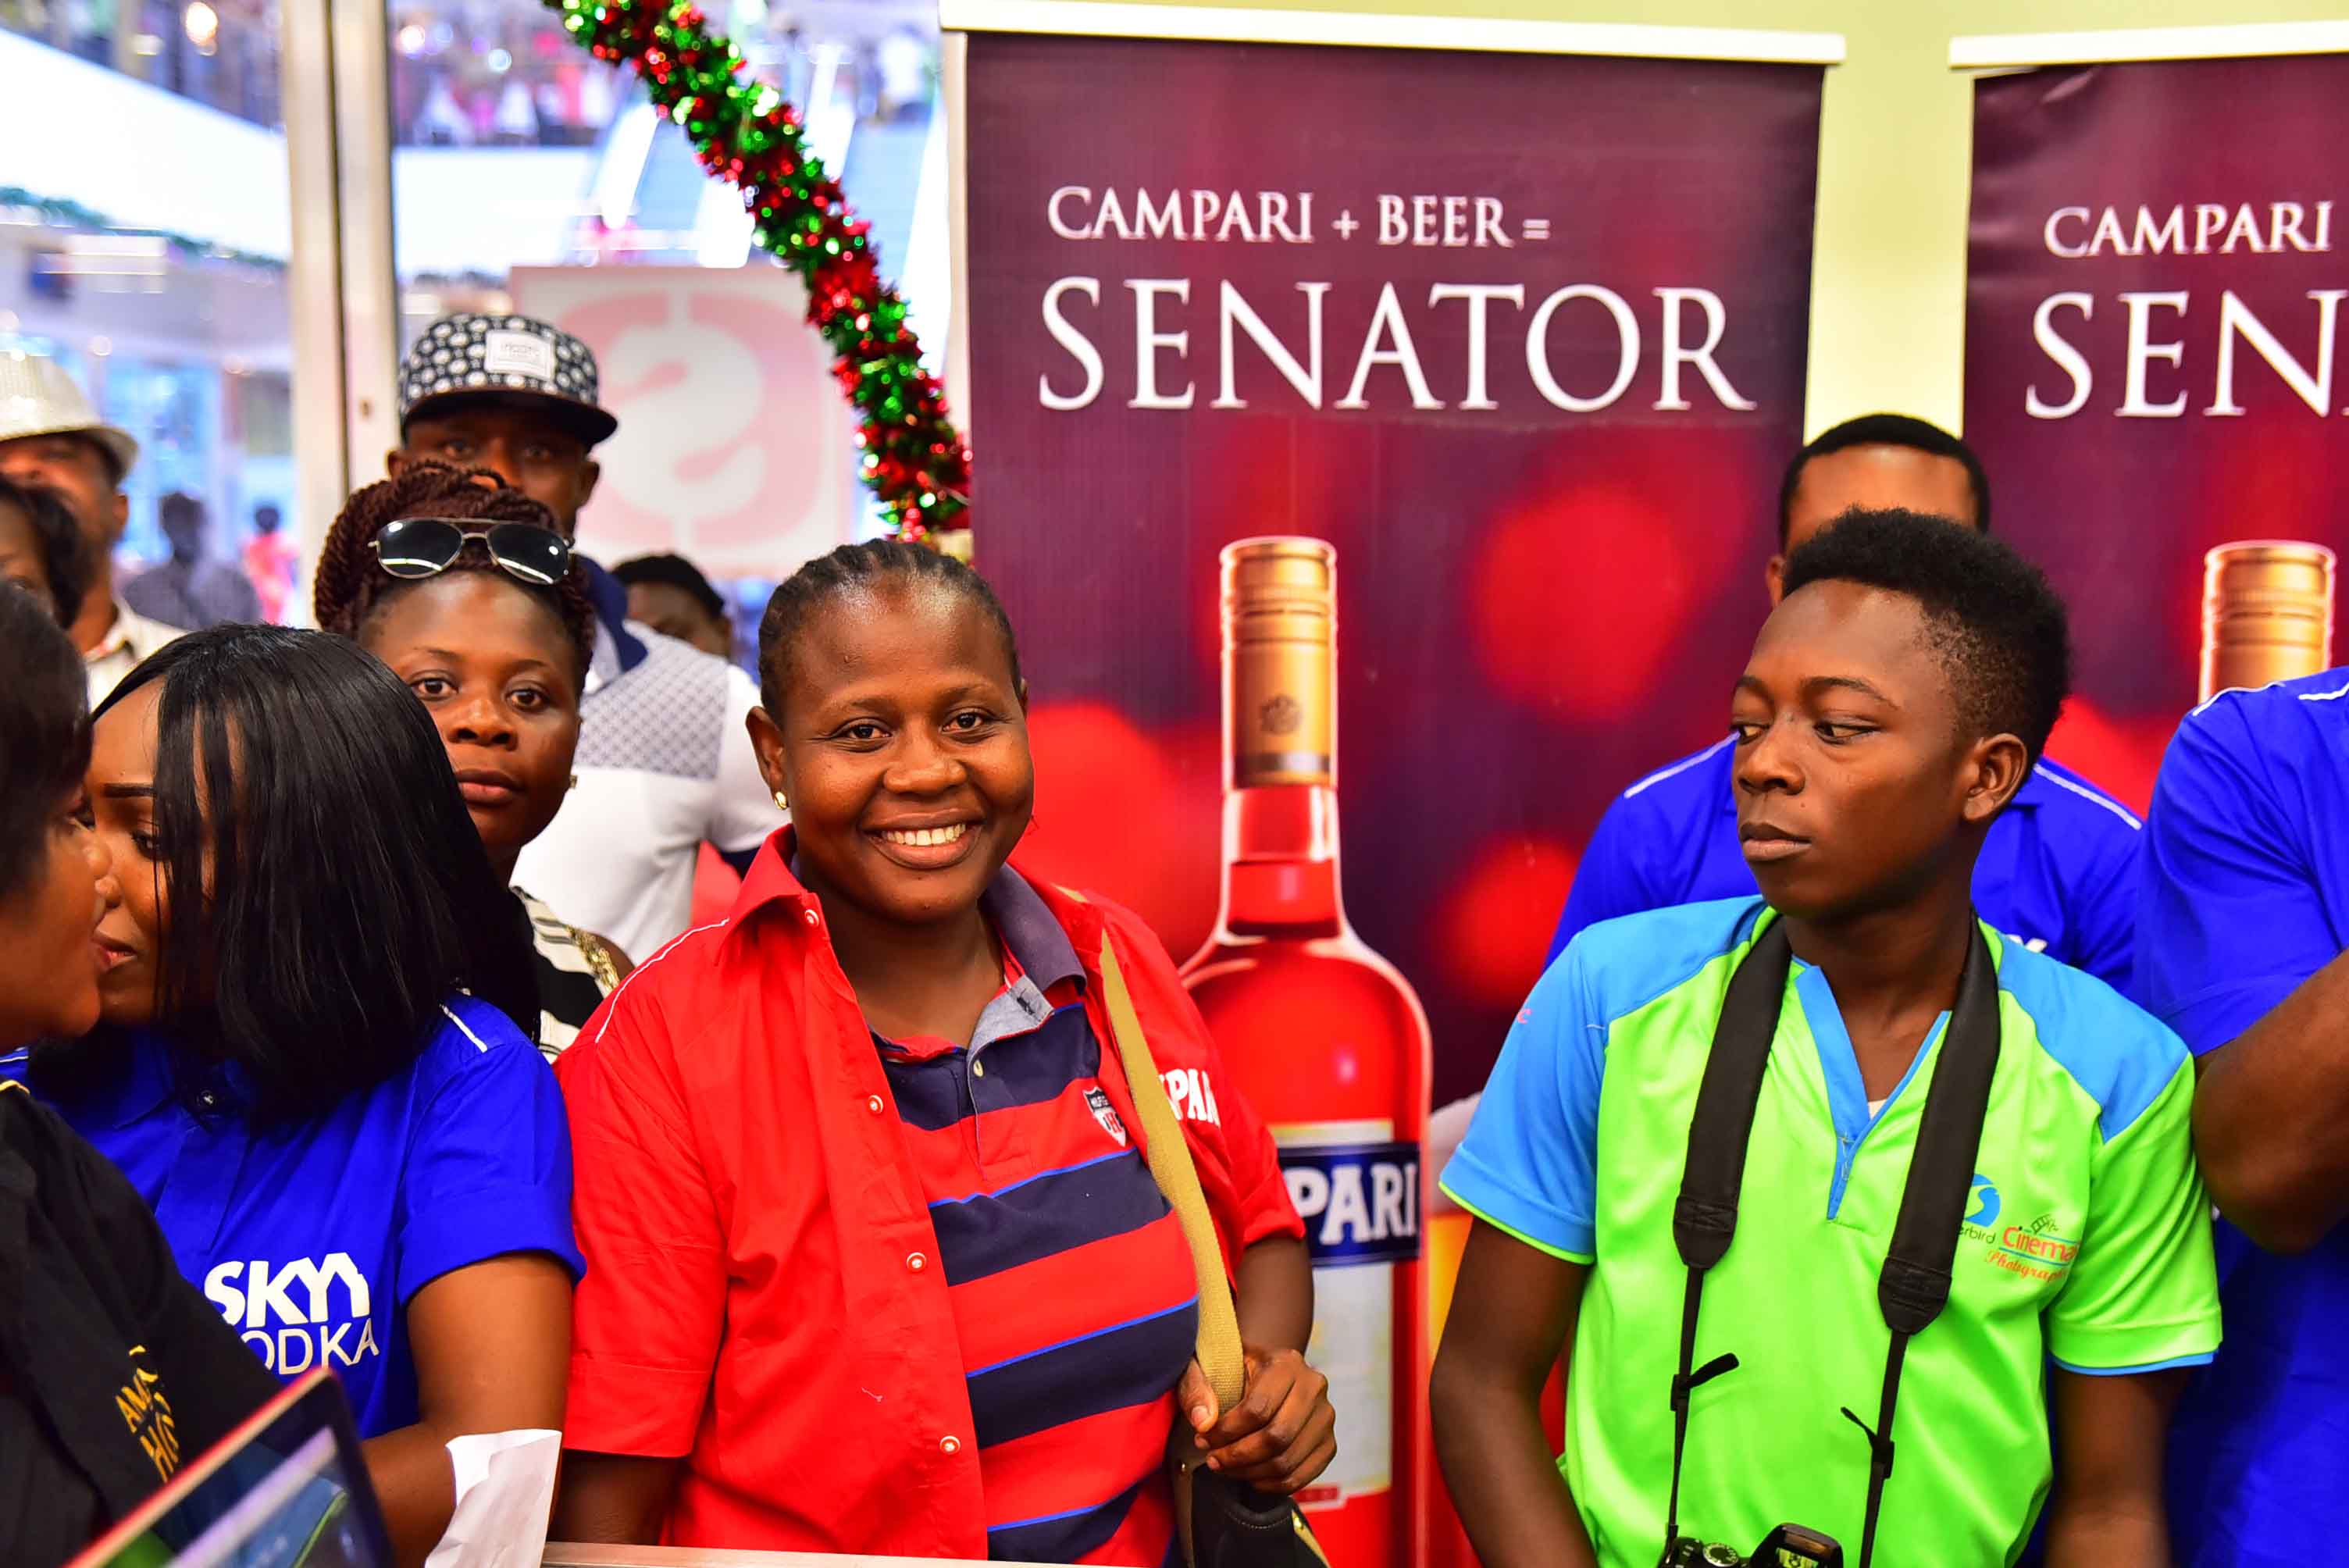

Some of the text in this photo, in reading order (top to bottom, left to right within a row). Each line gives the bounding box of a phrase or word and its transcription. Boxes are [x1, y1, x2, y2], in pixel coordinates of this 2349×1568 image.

[1047, 186, 1314, 244] CAMPARI
[1376, 194, 1515, 248] BEER
[2043, 200, 2334, 258] CAMPARI
[1038, 274, 1758, 413] SENATOR
[2024, 289, 2349, 419] SEN
